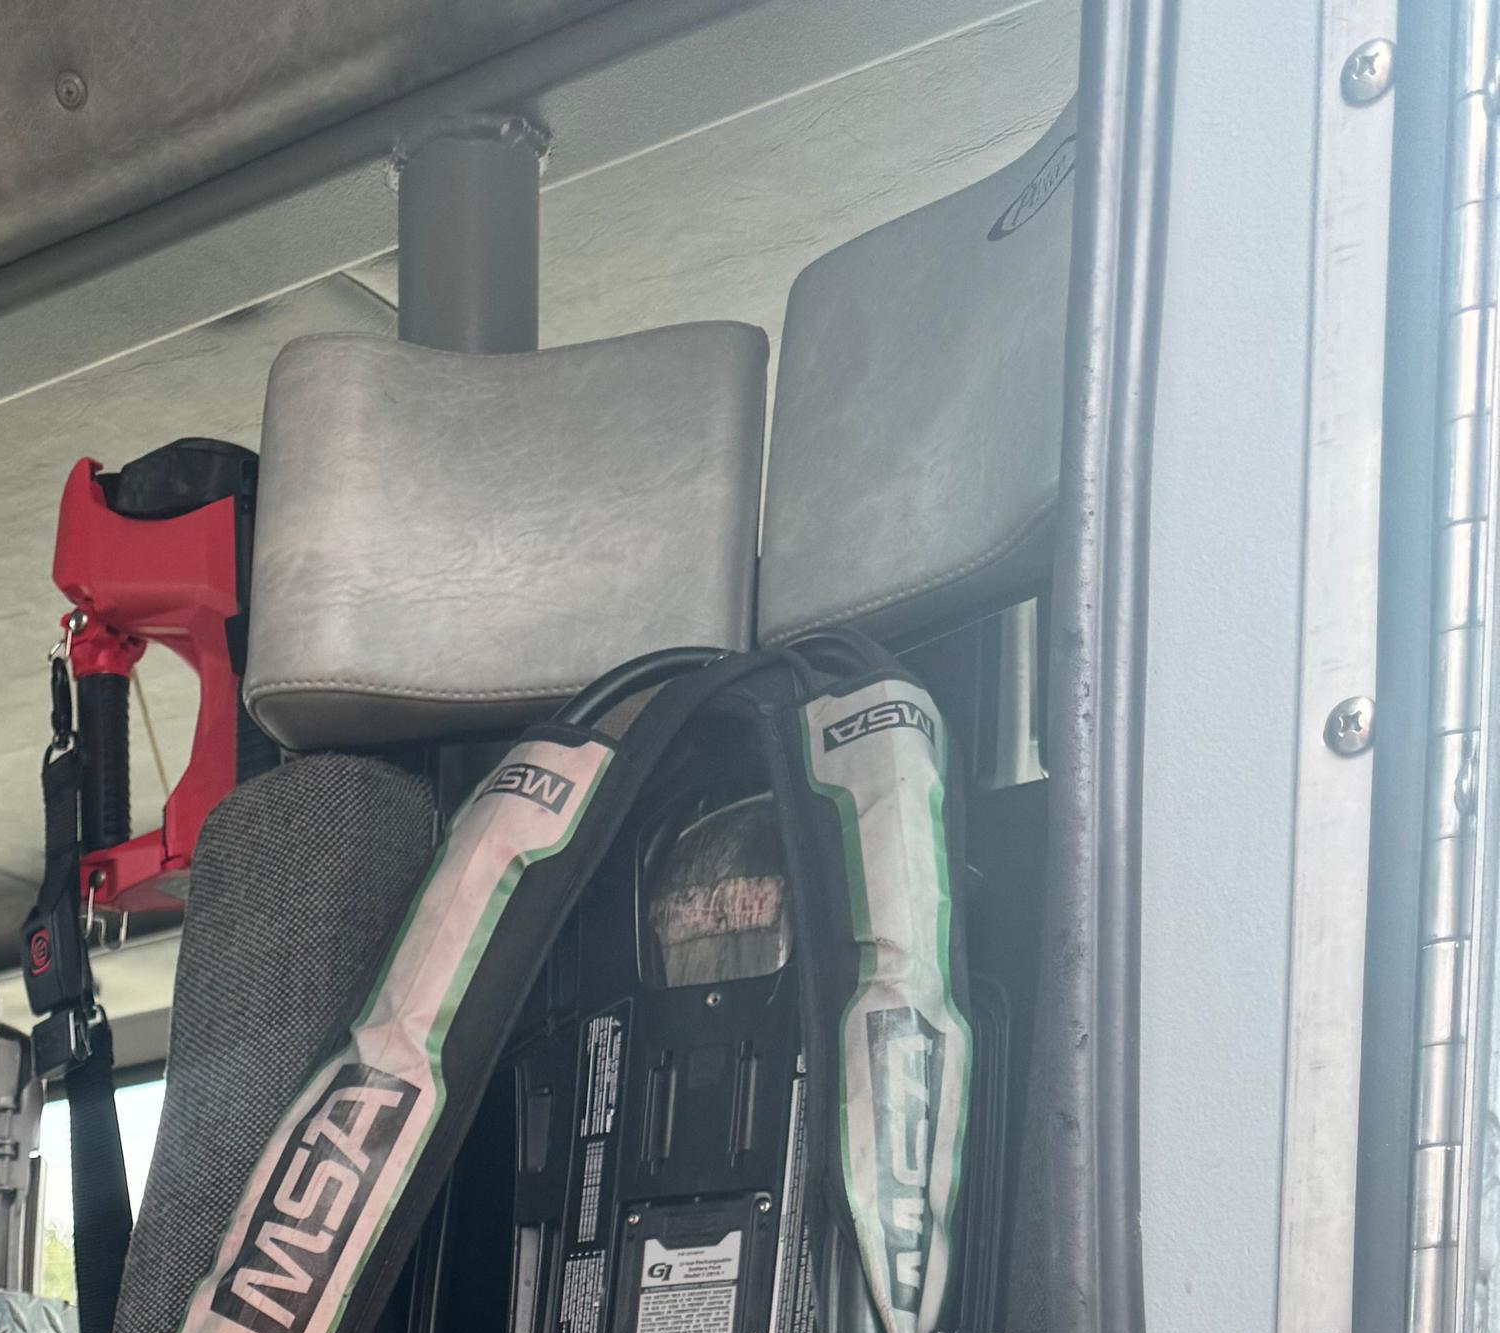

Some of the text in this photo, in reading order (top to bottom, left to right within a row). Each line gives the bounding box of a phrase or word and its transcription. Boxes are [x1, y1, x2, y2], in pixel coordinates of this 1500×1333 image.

[828, 703, 932, 743] MSA
[485, 766, 567, 806] MS
[230, 1086, 405, 1330] MSA
[648, 1262, 673, 1281] G1
